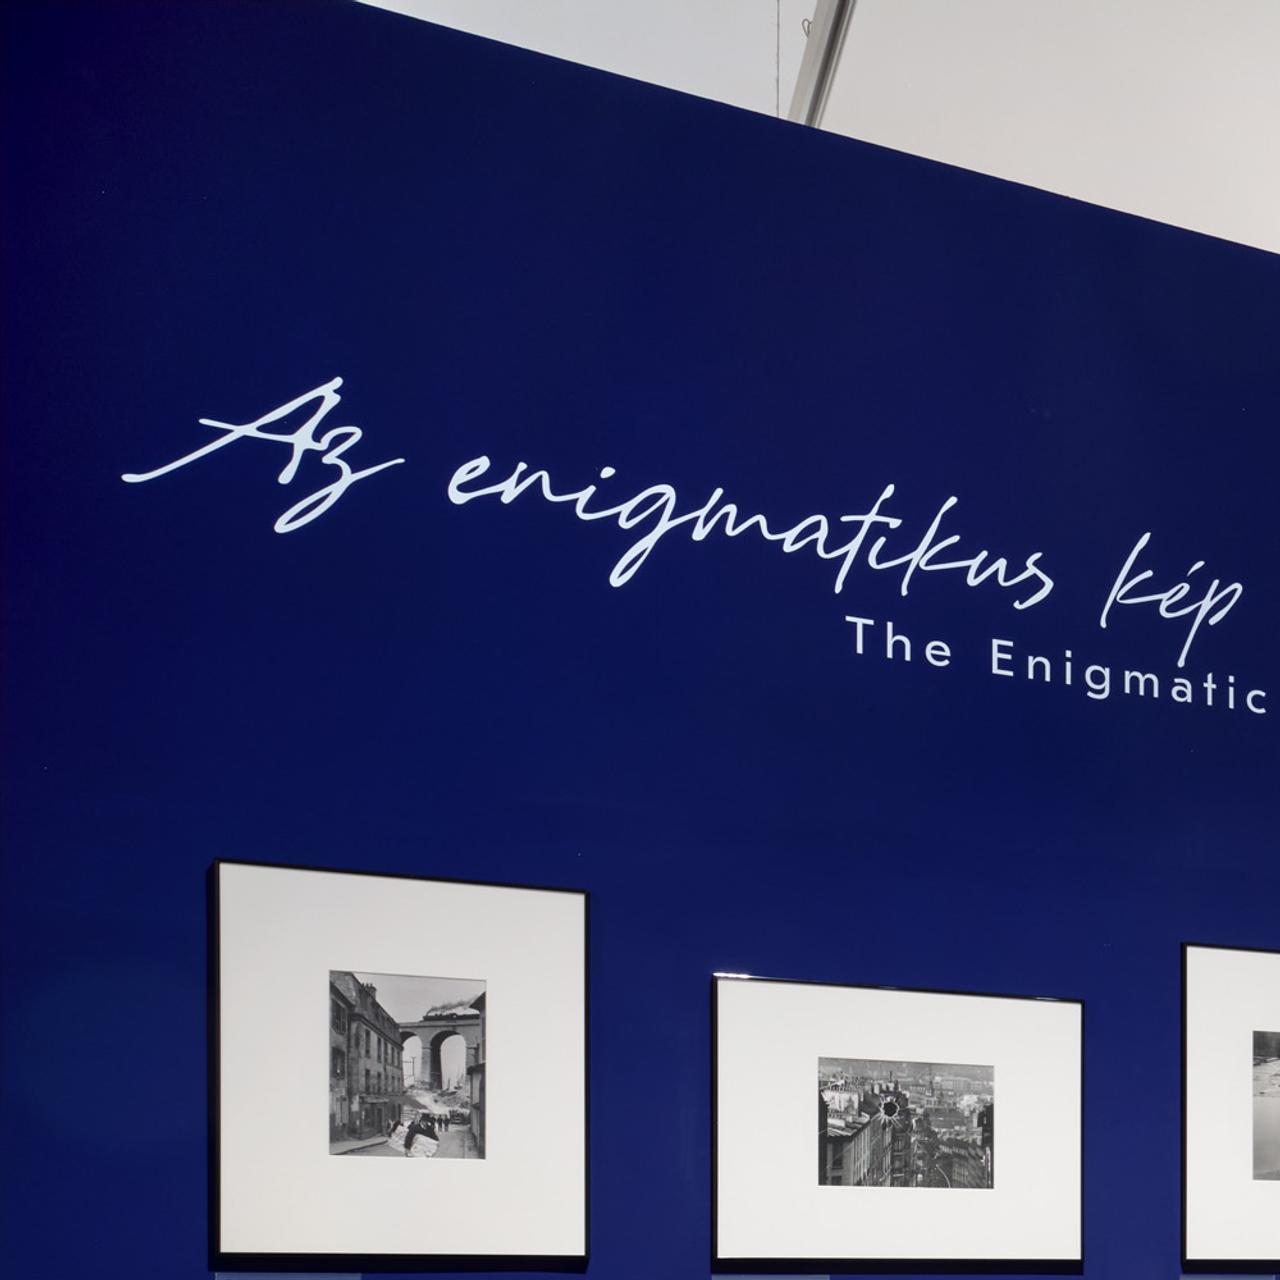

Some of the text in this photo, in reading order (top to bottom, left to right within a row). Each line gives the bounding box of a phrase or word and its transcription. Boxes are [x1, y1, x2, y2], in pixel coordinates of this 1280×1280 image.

[122, 377, 1242, 667] Az enigmatikus kép
[846, 616, 950, 666] The
[992, 639, 1265, 713] Enigmatic
